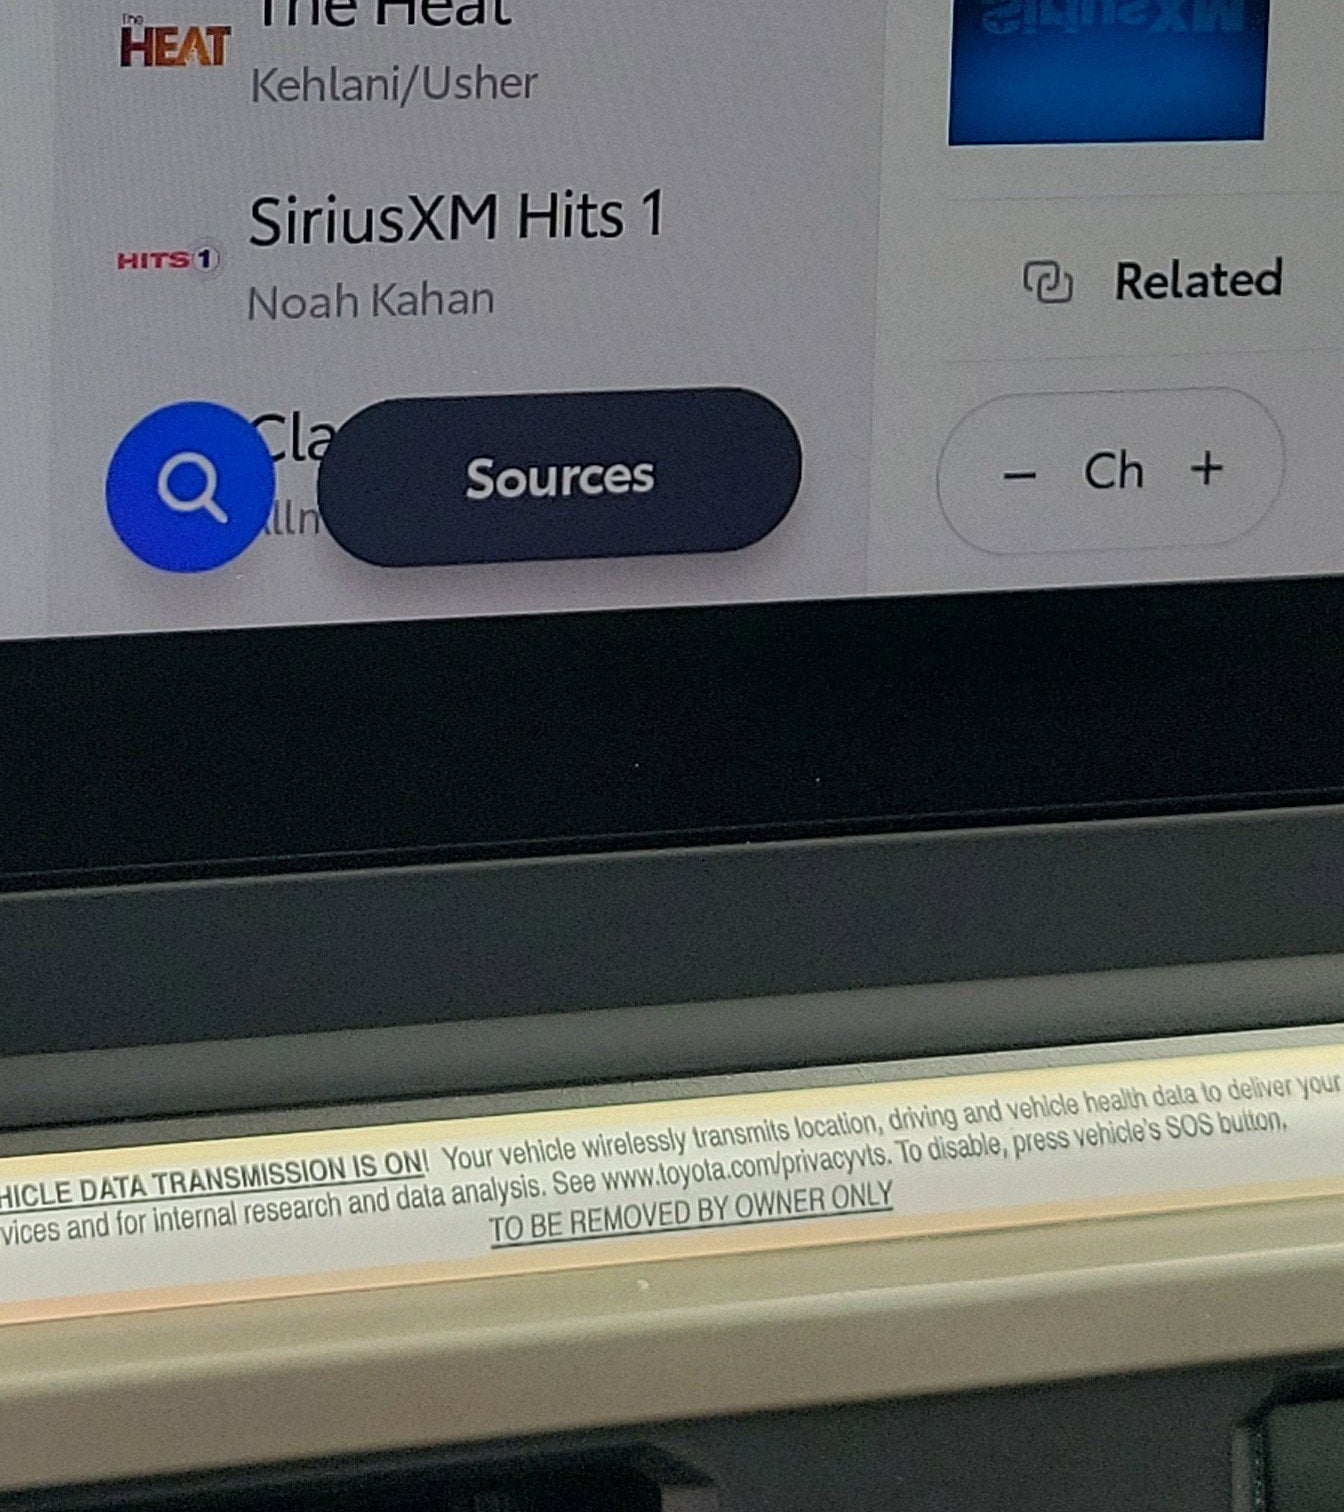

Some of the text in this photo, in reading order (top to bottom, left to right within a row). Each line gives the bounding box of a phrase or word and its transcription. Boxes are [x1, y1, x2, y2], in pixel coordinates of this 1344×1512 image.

[120, 25, 233, 68] HEAT
[251, 63, 540, 110] Kehlani/Usher
[249, 187, 663, 248] SiriusXM Hits 1
[117, 251, 191, 270] HITS
[1115, 256, 1284, 301] Related
[247, 278, 495, 322] Noah Kahan
[465, 456, 656, 502] Sources
[1084, 447, 1145, 491] Ch
[80, 1174, 148, 1202] DATA
[151, 1156, 346, 1195] TRANSMISSION
[353, 1154, 378, 1178] IS
[385, 1148, 430, 1175] ON!
[441, 1146, 494, 1171] Your
[498, 1137, 576, 1166] vehicle
[582, 1127, 686, 1158] wirelessly
[693, 1118, 790, 1148] transmits
[795, 1112, 883, 1139] location,
[889, 1104, 957, 1131] driving
[963, 1098, 1002, 1124] and
[1006, 1093, 1079, 1120] vehicle
[1083, 1087, 1148, 1113] health
[1153, 1084, 1199, 1107] data
[1201, 1081, 1222, 1103] to
[1228, 1076, 1292, 1101] deliver
[1297, 1074, 1341, 1100] your
[68, 1213, 110, 1240] and
[116, 1209, 147, 1236] for
[153, 1200, 237, 1233] internal
[244, 1192, 342, 1224] research
[349, 1187, 390, 1215] and
[396, 1184, 446, 1210] data
[452, 1174, 546, 1207] analysis.
[553, 1170, 596, 1195] See
[602, 1144, 892, 1191] www.toyota.com/privacyvts.
[895, 1138, 922, 1163] To
[928, 1132, 1008, 1161] disable,
[1013, 1128, 1070, 1160] press
[1073, 1118, 1161, 1147] vehicle's
[1166, 1112, 1214, 1139] SOS
[489, 1179, 893, 1242] TO BE REMOVED BY OWNER ONLY
